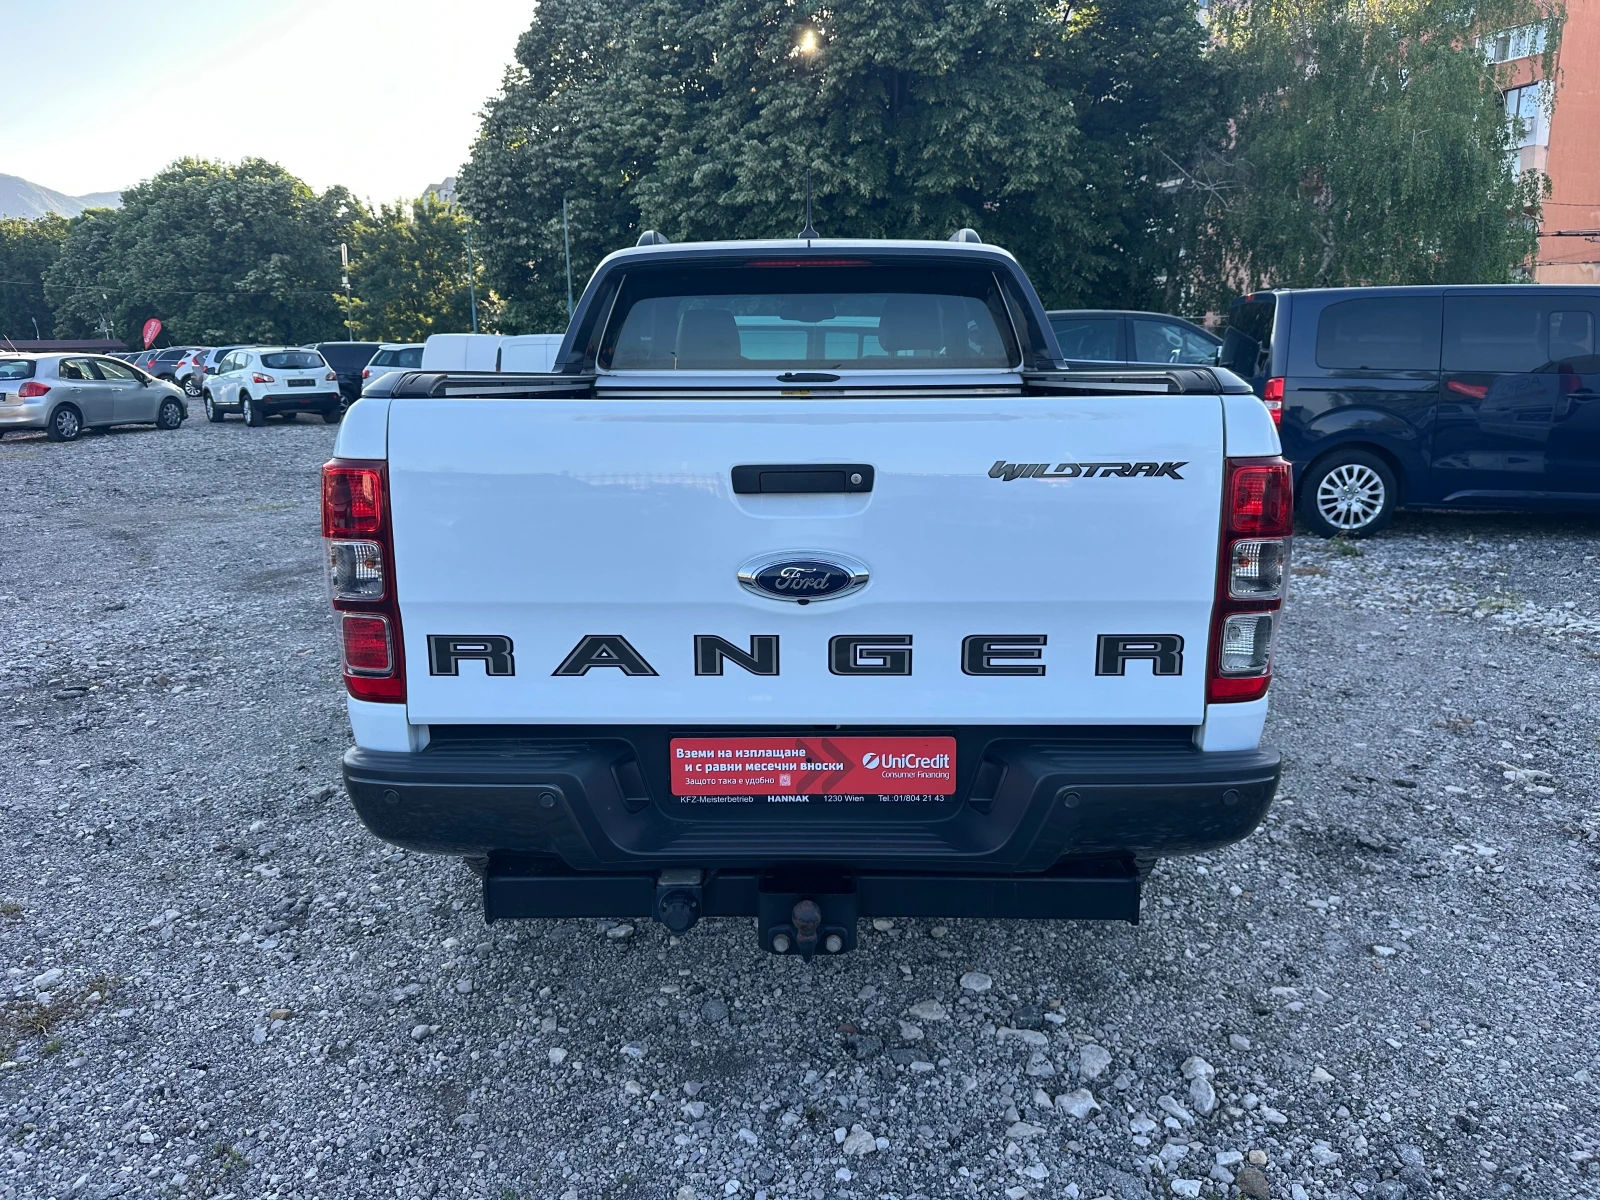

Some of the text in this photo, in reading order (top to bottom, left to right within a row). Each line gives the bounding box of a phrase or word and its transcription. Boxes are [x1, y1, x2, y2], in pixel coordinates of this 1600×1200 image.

[988, 460, 1190, 482] WILDTRAK
[775, 566, 830, 590] Ford
[426, 633, 1185, 677] RANGER
[676, 748, 806, 759] Вземи на изплащане
[881, 753, 950, 769] UniCredit
[684, 762, 844, 774] и с равни месечни вноски
[685, 777, 716, 786] Защото
[718, 777, 737, 785] така
[745, 776, 775, 786] удобно
[881, 770, 950, 780] Consumer Financing
[680, 795, 754, 804] KFZ-Meisterbetrieb
[767, 795, 810, 803] HANNAK
[877, 794, 920, 802] Tel.:01/804
[922, 794, 932, 802] 21
[933, 794, 945, 802] 43
